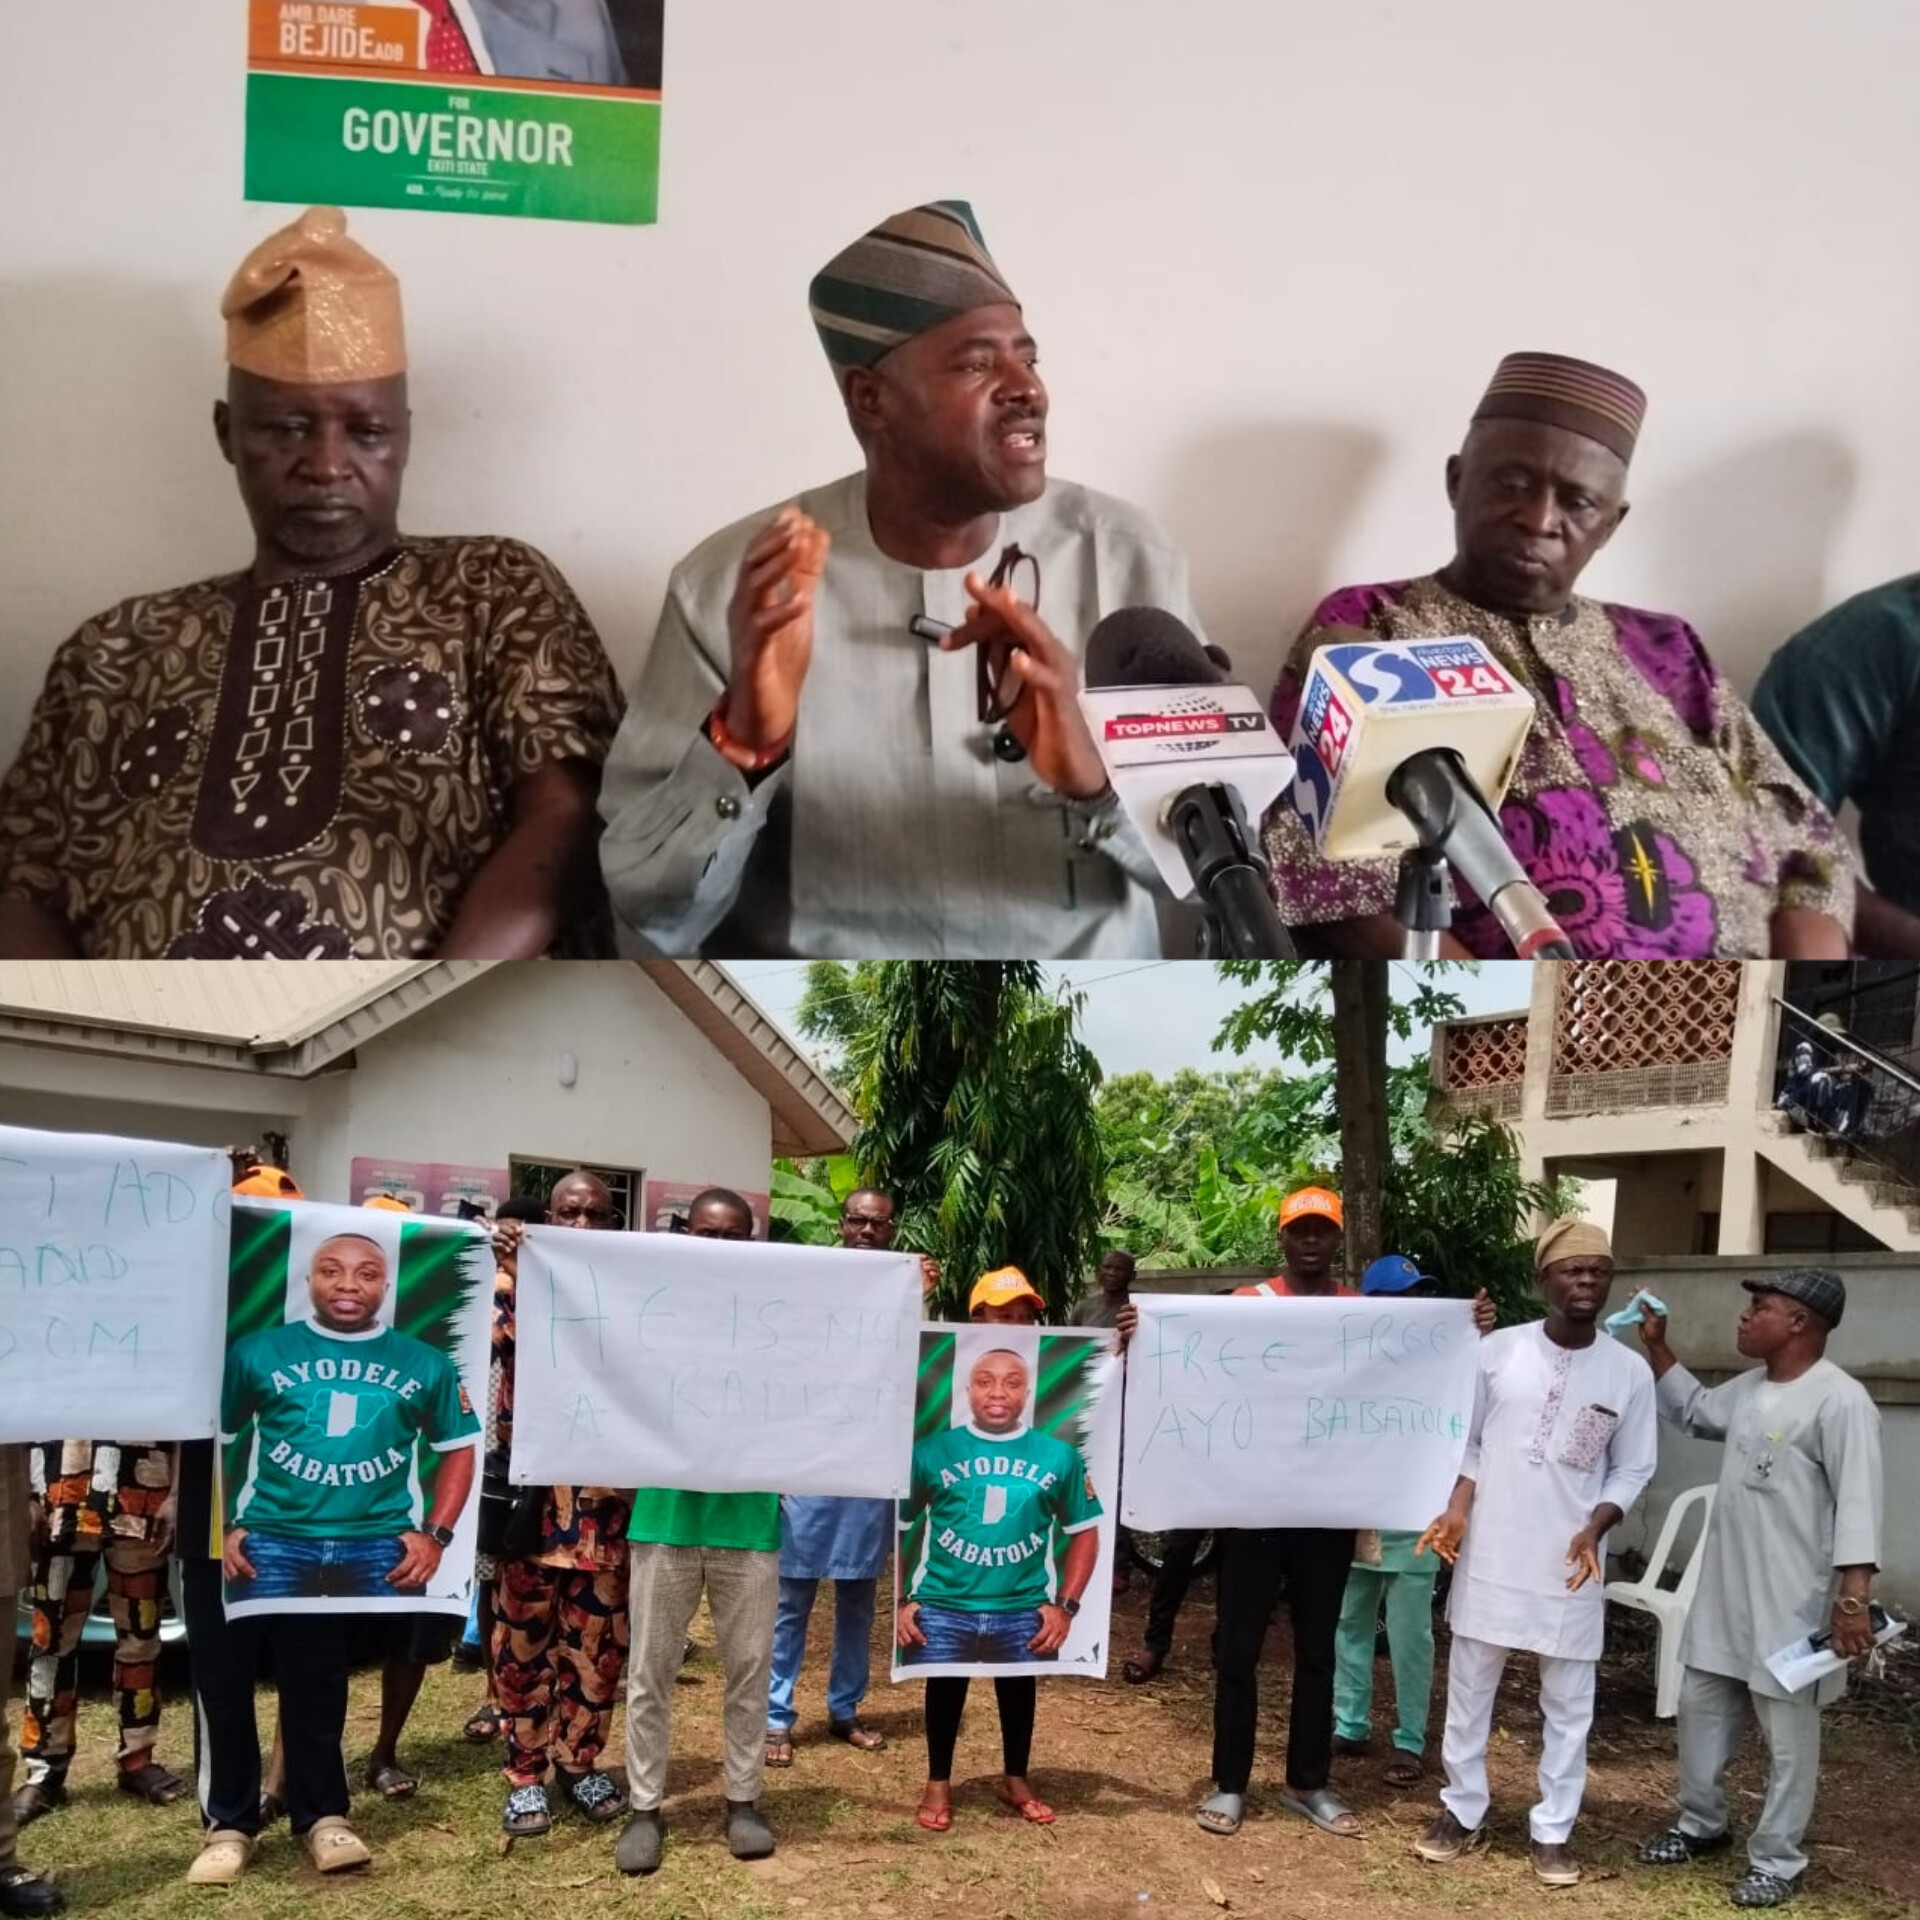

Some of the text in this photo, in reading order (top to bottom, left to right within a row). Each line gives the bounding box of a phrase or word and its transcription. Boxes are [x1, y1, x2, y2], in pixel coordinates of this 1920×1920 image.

[317, 5, 356, 26] DARE
[279, 21, 375, 60] BEJIDE
[448, 95, 470, 110] FOR
[342, 107, 574, 167] GOVERNOR
[427, 158, 489, 176] EKITI STATE
[1419, 651, 1486, 668] NEWS
[1437, 667, 1505, 695] 24
[1112, 716, 1259, 736] TOPNEWS TV
[1308, 682, 1331, 743] NEWS
[1320, 702, 1349, 771] 24
[731, 1294, 785, 1351] IS
[1145, 1313, 1448, 1398] FREE FREE
[271, 1358, 423, 1401] AYODELE
[1139, 1400, 1252, 1465] AYO
[268, 1440, 407, 1487] BABATOLA
[939, 1456, 1058, 1491] AYODELE
[937, 1527, 1044, 1568] BABATOLA
